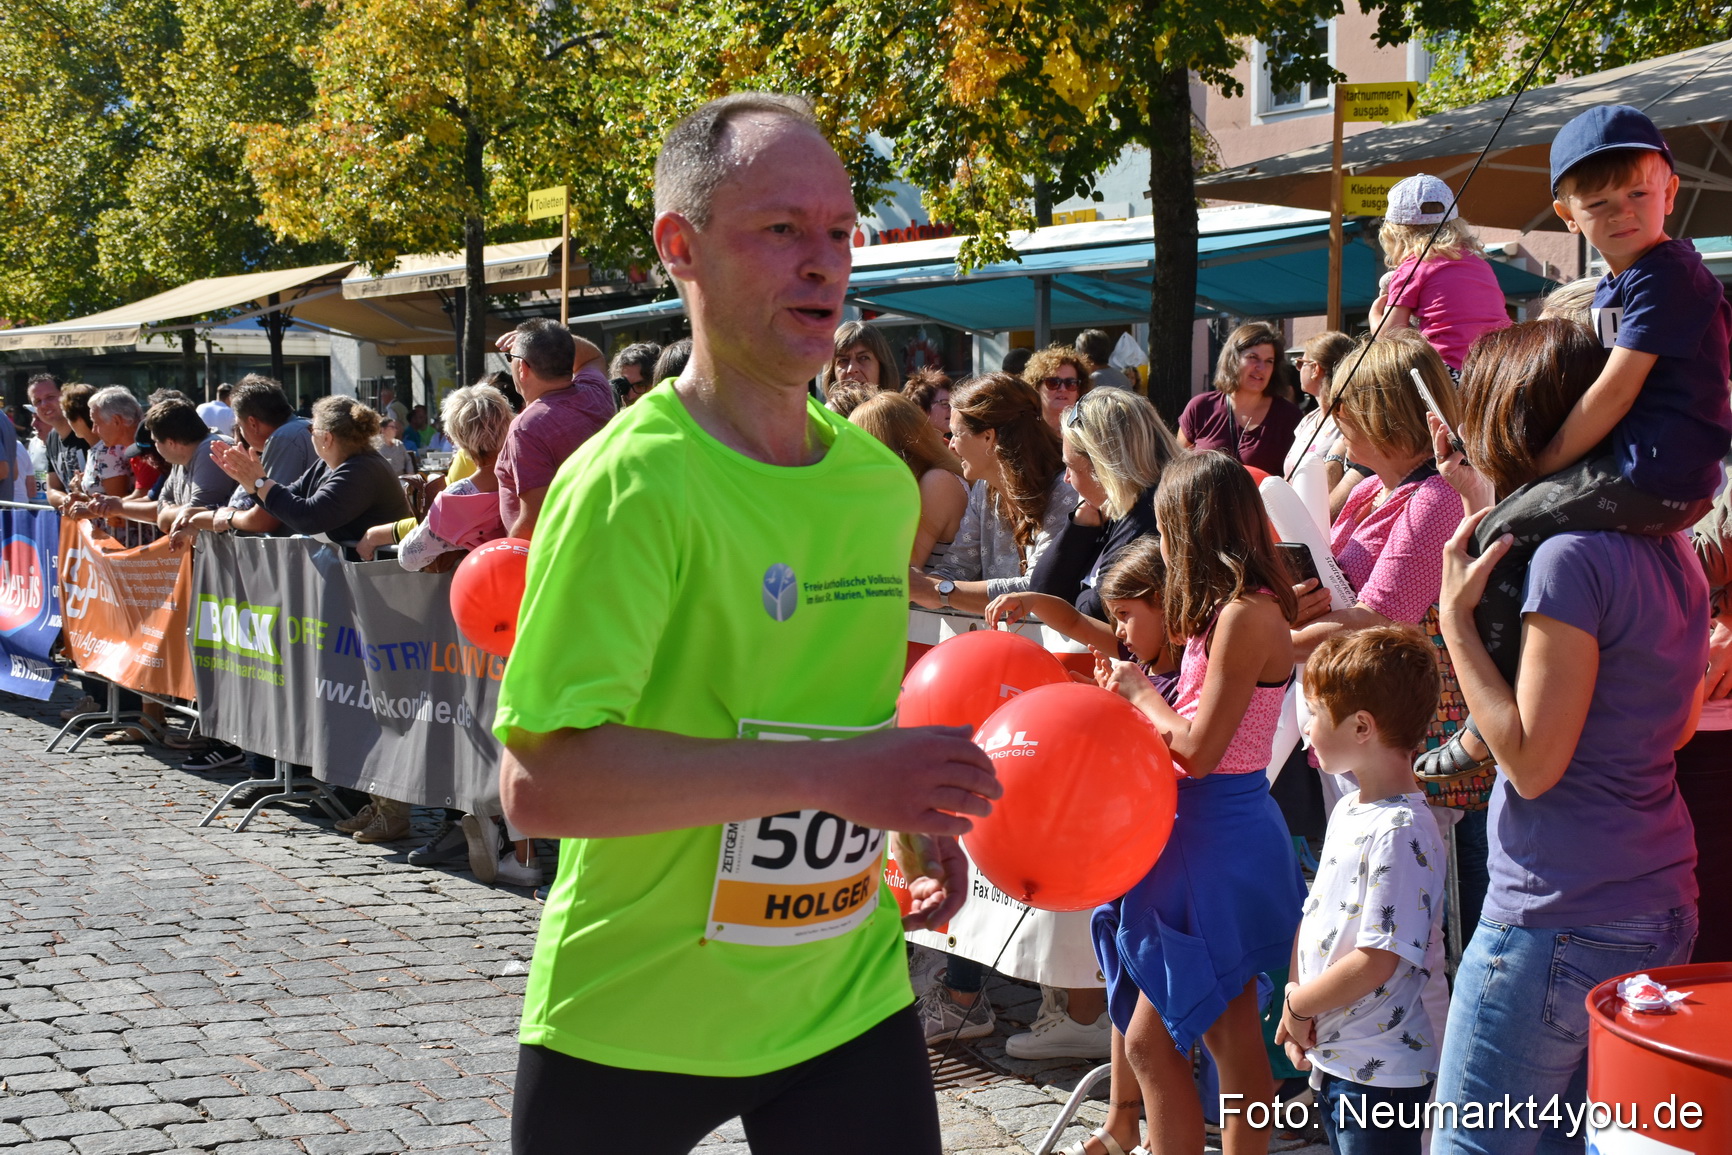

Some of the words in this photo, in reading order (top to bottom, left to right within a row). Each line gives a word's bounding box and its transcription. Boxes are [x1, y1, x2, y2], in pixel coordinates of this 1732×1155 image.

[1344, 90, 1403, 102] tartnummern-
[1353, 104, 1389, 119] ausgabe
[535, 197, 564, 211] Toiletten
[198, 600, 274, 657] BOCK
[765, 875, 870, 920] HOLGER
[973, 879, 989, 900] Fax
